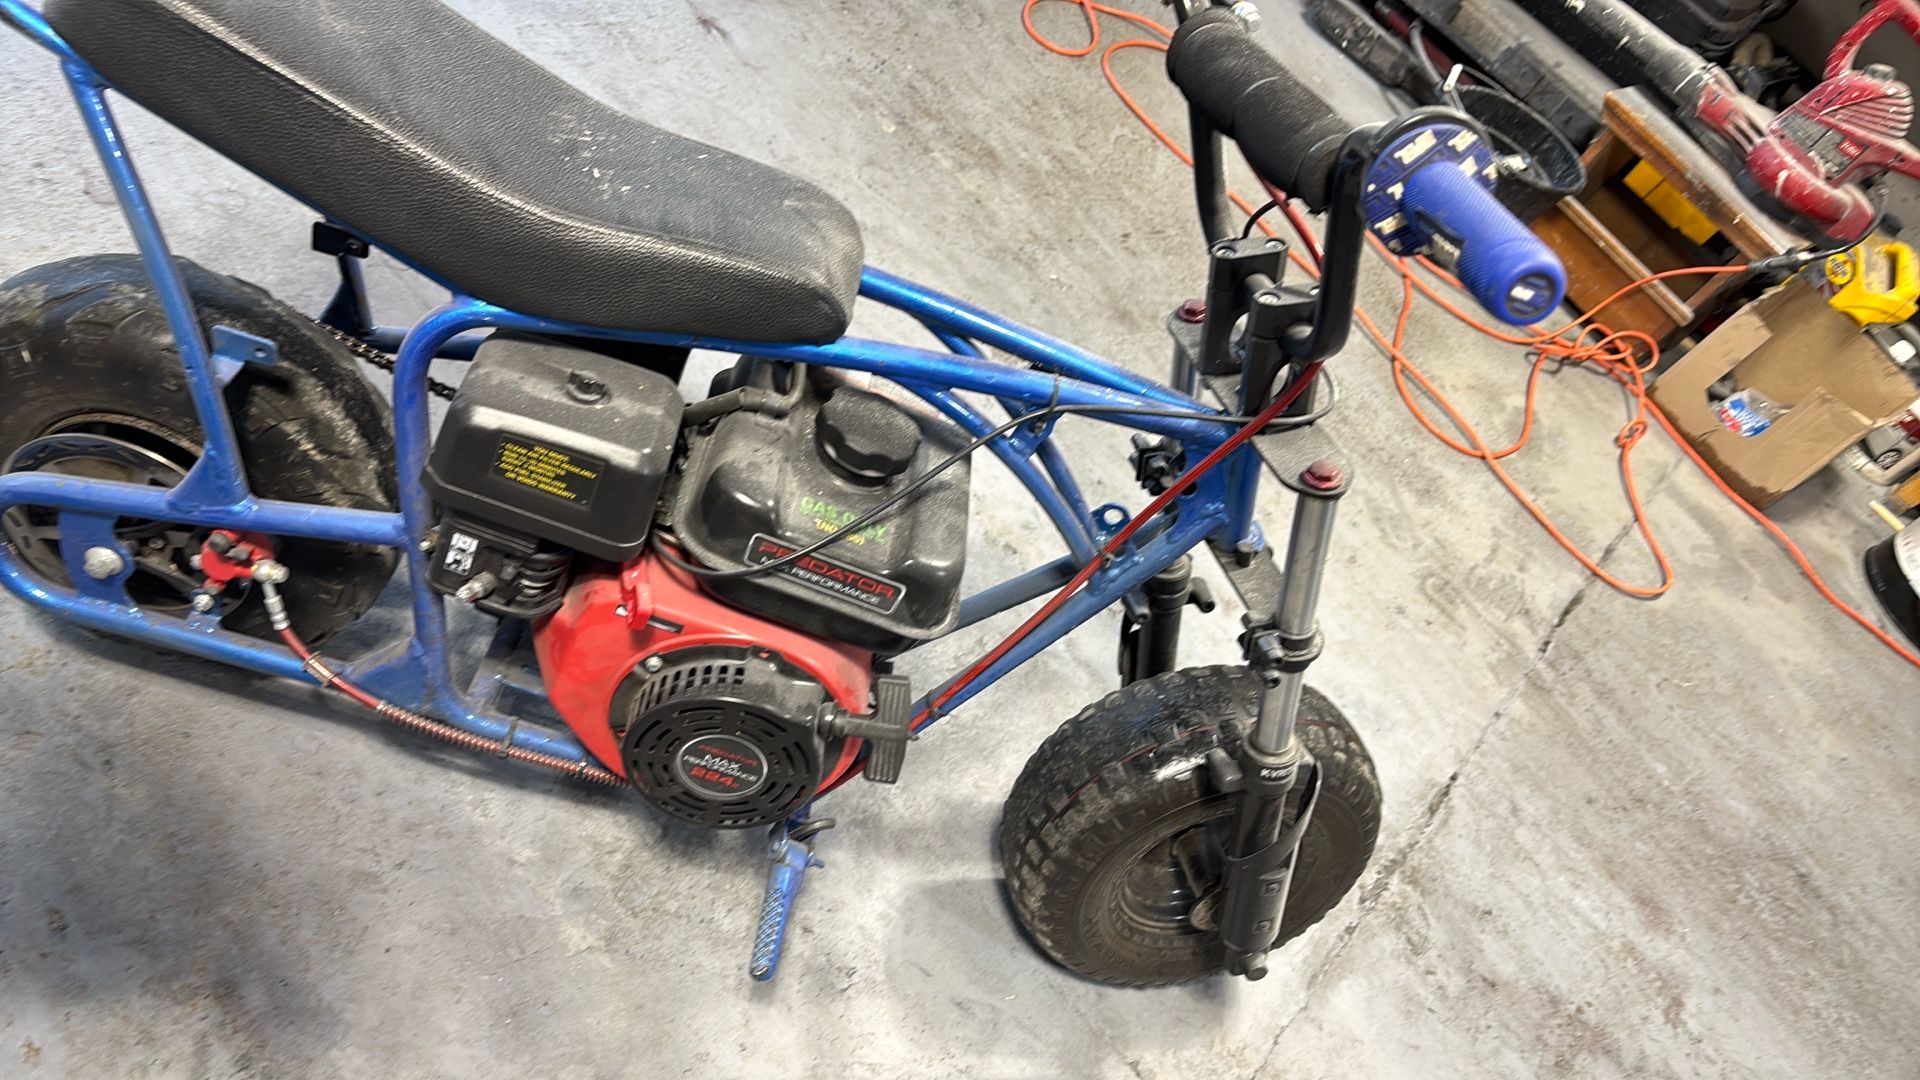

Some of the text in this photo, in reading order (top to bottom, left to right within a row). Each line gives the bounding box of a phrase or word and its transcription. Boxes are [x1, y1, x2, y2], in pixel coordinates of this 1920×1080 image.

[800, 496, 839, 520] GAS
[791, 567, 882, 605] PERFORMANCE
[703, 754, 742, 771] MAX
